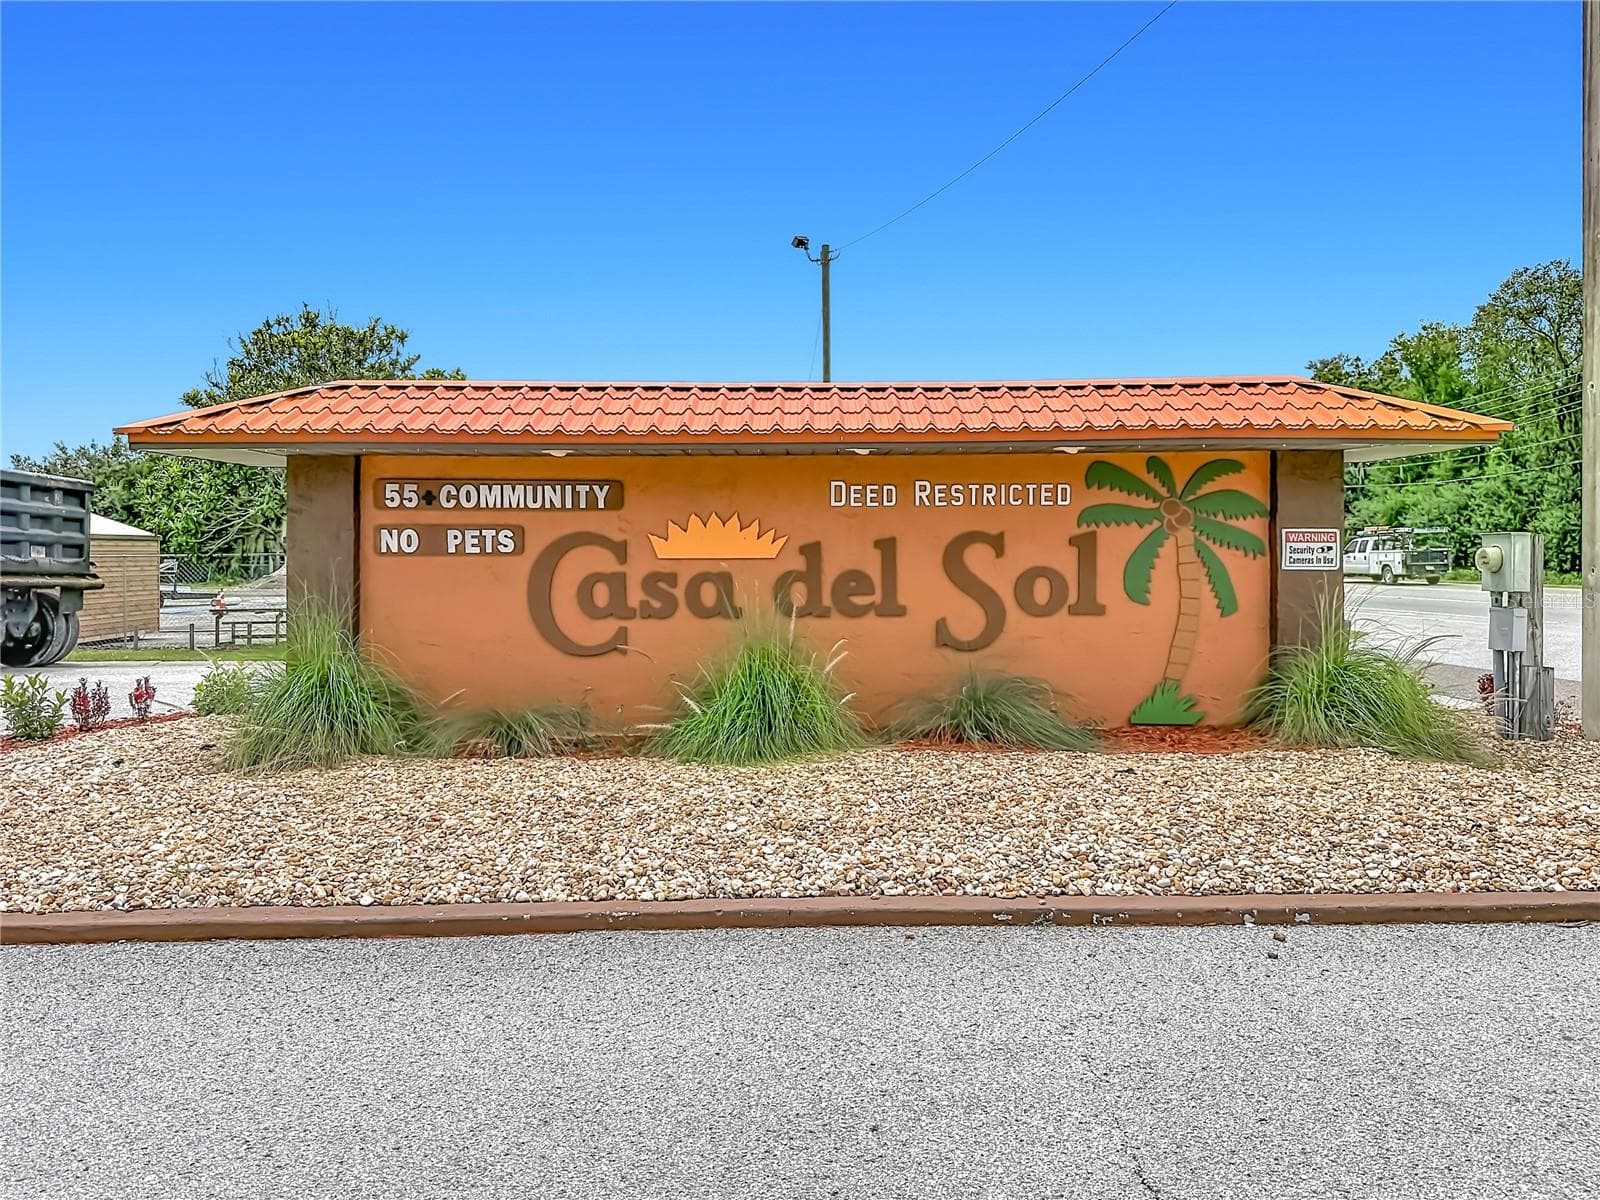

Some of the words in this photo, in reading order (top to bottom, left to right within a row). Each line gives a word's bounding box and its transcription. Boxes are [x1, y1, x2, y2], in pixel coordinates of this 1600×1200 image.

[380, 528, 419, 553] NO
[446, 528, 515, 554] PETS
[1288, 533, 1335, 542] WARNING
[1288, 545, 1315, 556] Security
[1288, 556, 1314, 565] Cameras
[1316, 556, 1321, 565] In
[1323, 556, 1334, 565] Use
[527, 531, 742, 656] Casa
[773, 537, 906, 619] del
[936, 530, 1106, 652] Sol
